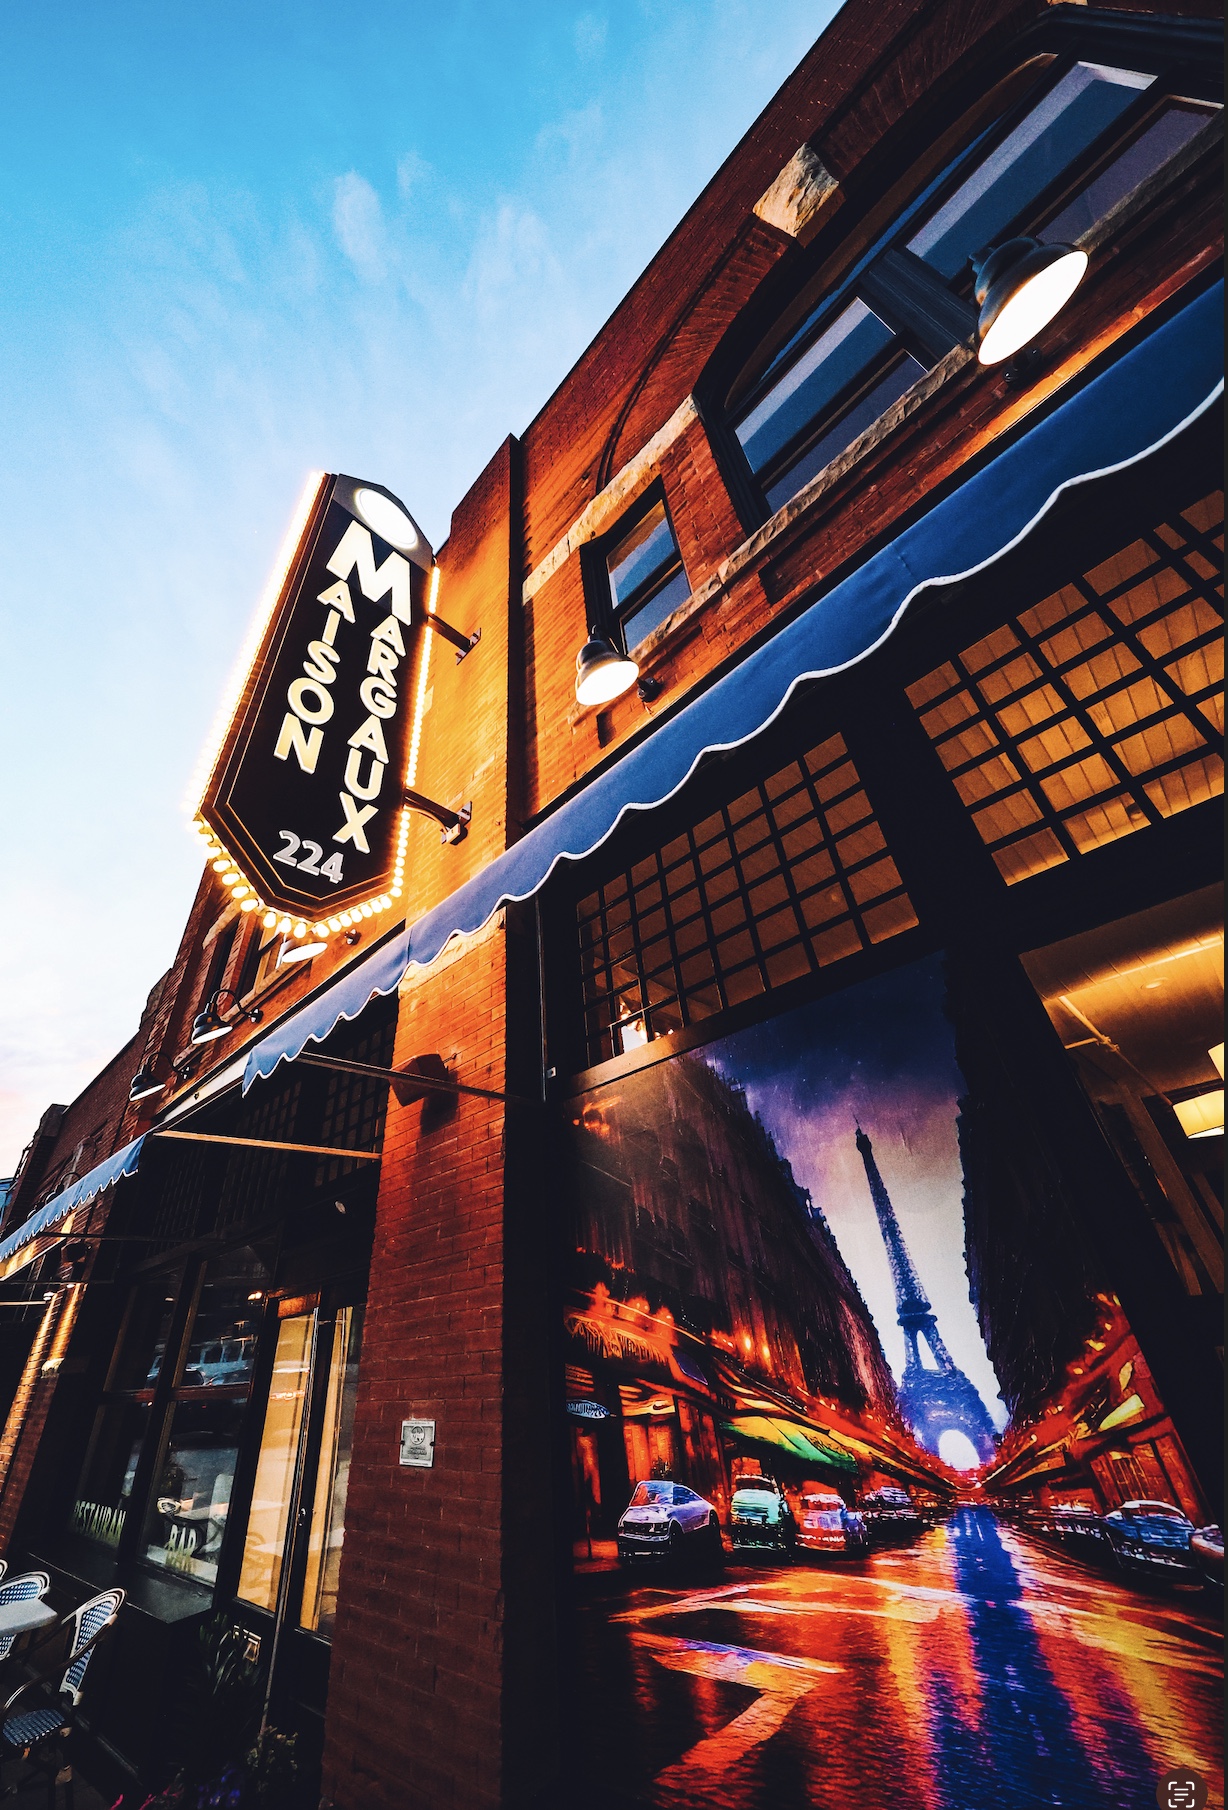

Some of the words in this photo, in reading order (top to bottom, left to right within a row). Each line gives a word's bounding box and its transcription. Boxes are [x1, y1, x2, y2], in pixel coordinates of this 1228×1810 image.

[273, 519, 411, 774] MAISON
[326, 519, 411, 854] MARGAUX
[273, 830, 345, 884] 224
[73, 1500, 127, 1541] RESTAURAN
[168, 1524, 196, 1561] BAR
